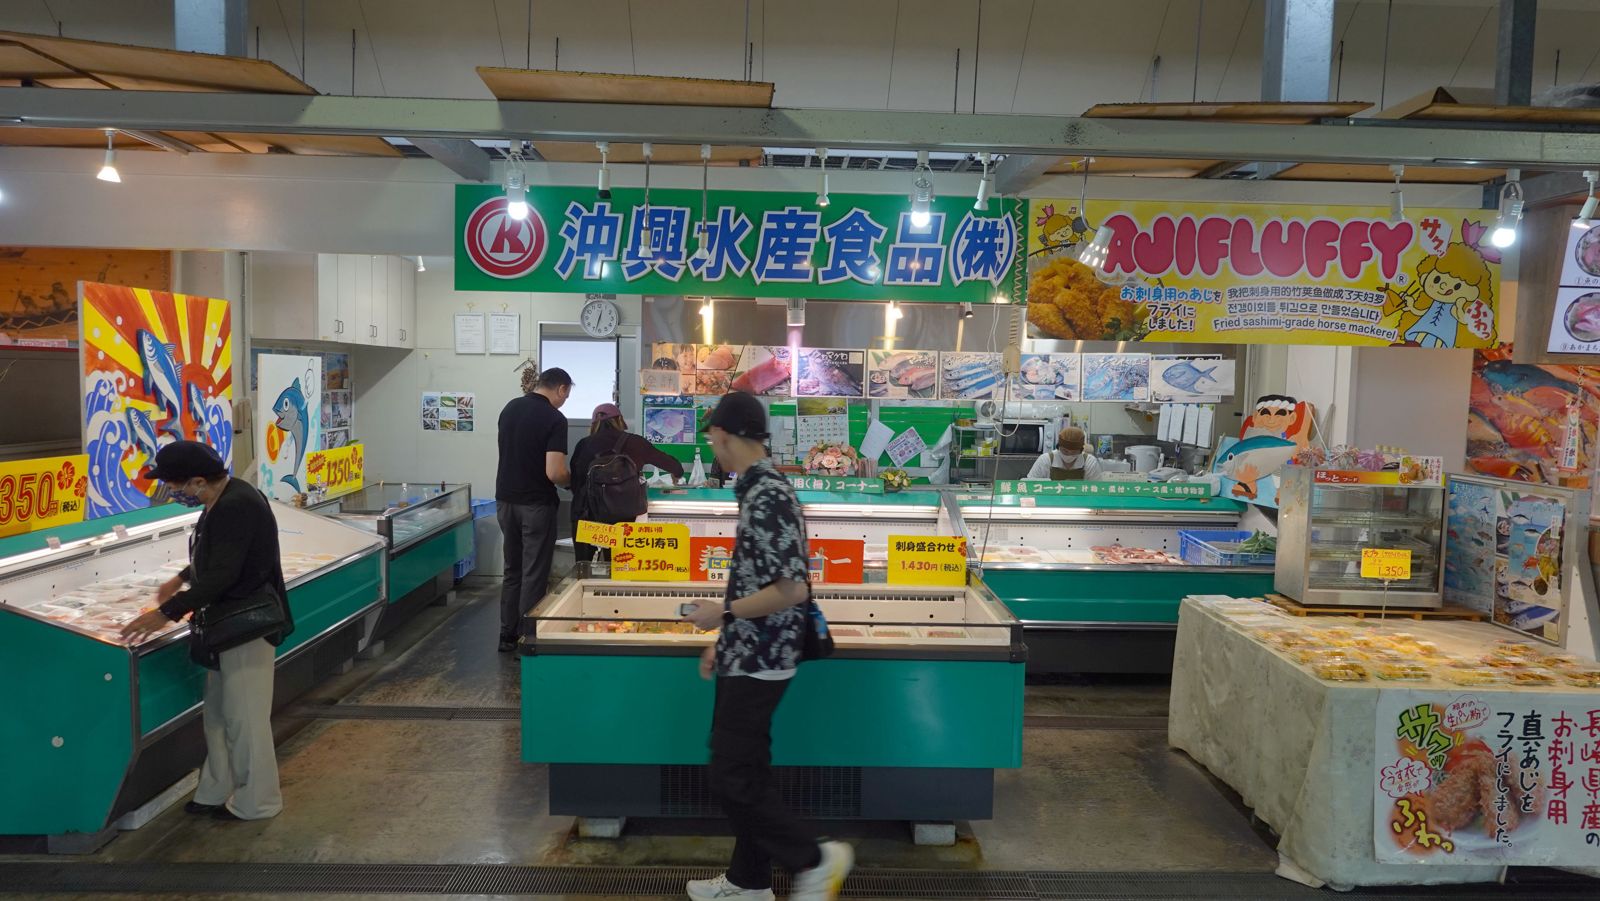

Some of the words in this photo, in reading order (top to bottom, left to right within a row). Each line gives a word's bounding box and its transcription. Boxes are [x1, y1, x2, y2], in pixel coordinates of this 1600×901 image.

[555, 200, 1014, 287] 沖興水産食品(株)
[1102, 214, 1413, 280] AJIFLUFFY
[1121, 286, 1221, 302] お刺身用のあじを
[1148, 303, 1195, 317] フライに
[1279, 302, 1318, 314] 튀김으로
[1321, 304, 1380, 321] 만들었습니다
[1467, 300, 1490, 339] ふわっ
[1148, 318, 1194, 330] しました!
[1213, 317, 1241, 330] Fried
[1243, 316, 1315, 329] sashimi-grade
[1317, 318, 1347, 331] horse
[1349, 323, 1397, 341] mackerel
[1316, 471, 1340, 483] ほっと
[1000, 482, 1077, 494] 鮮魚コーナー
[592, 533, 617, 546] 480円
[623, 537, 679, 549] にぎり寿司
[895, 541, 956, 553] 刺身盛合わせ
[1517, 710, 1545, 812] 真あじを
[1547, 710, 1578, 825] お刺身用
[1387, 763, 1423, 785] うす衣で
[1494, 712, 1515, 848] フライにしました。
[1392, 799, 1453, 852] ふわっ
